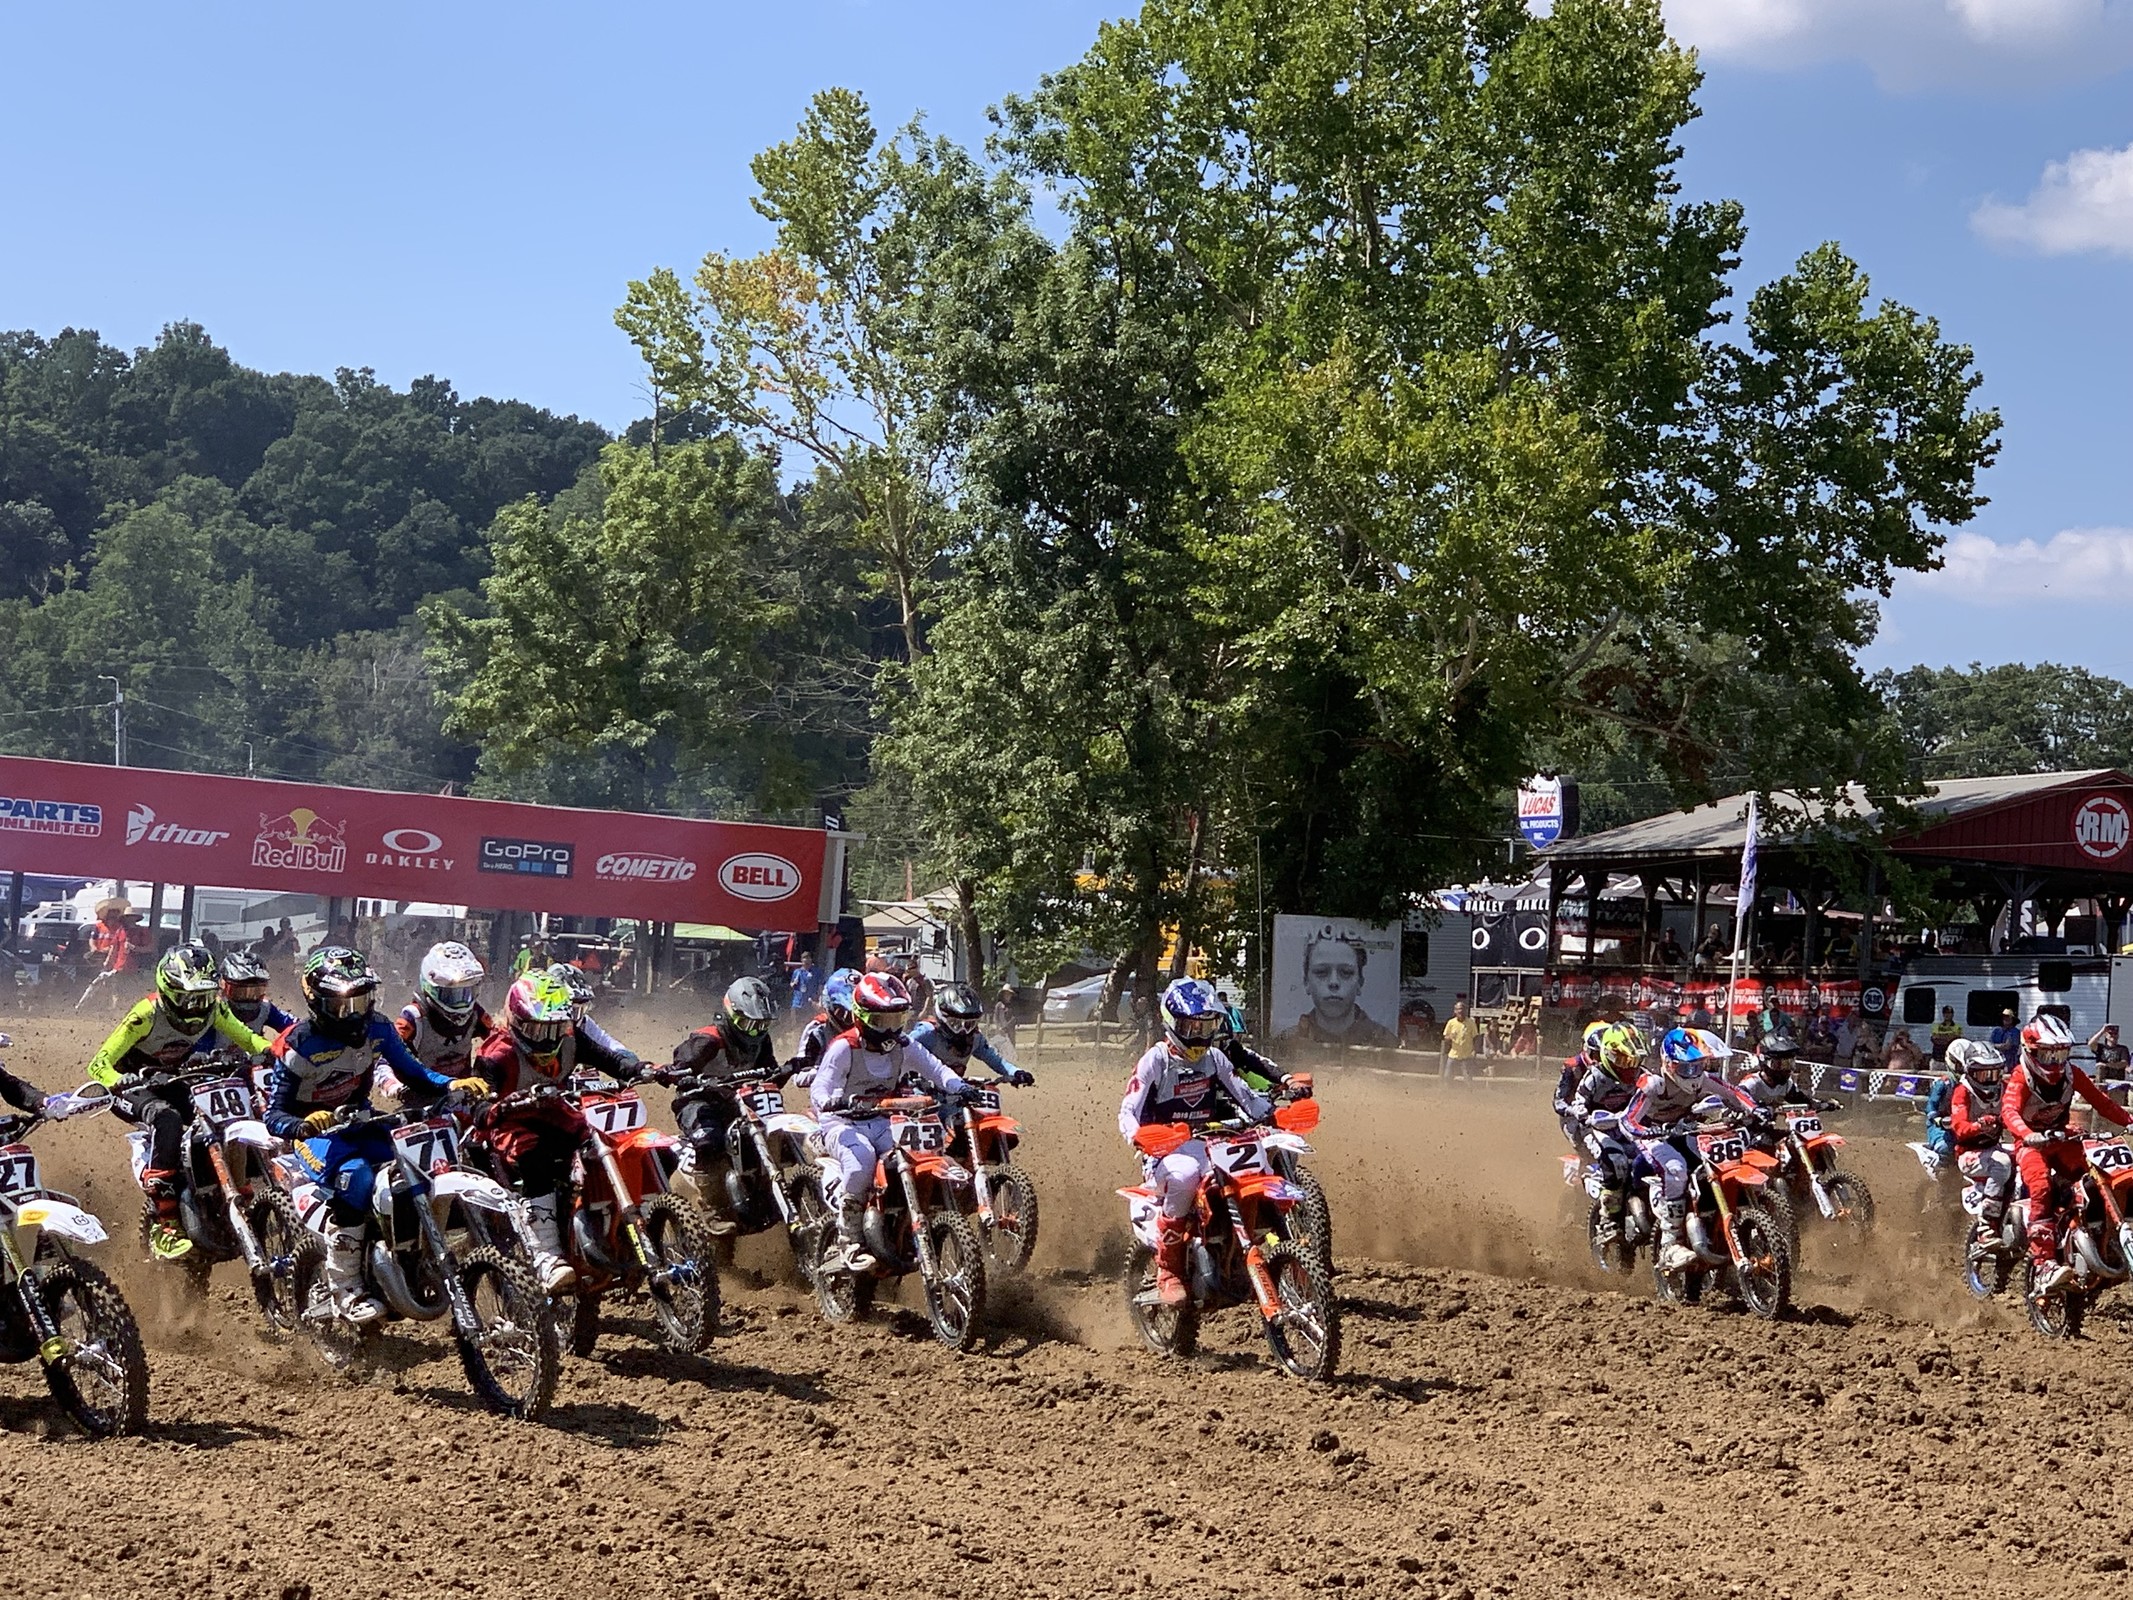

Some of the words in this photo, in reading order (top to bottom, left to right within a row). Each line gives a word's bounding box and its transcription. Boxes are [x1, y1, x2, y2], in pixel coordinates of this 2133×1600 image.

[1522, 796, 1556, 815] LUCAS
[0, 816, 100, 836] NLIMITED
[148, 823, 230, 846] thor
[1530, 820, 1559, 829] PRODUCTS
[2083, 811, 2121, 843] RM
[252, 840, 300, 869] Red
[300, 843, 346, 873] Bull
[365, 852, 455, 871] OAKLEY
[484, 840, 570, 862] GoPro
[596, 854, 697, 881] COMETIC
[732, 865, 788, 887] BELL
[1464, 900, 1505, 912] OAKLEY
[210, 1088, 246, 1118] 48
[754, 1092, 784, 1113] 32
[595, 1101, 638, 1131] 77
[1795, 1119, 1821, 1133] 68
[899, 1124, 943, 1151] 43
[405, 1129, 458, 1172] 71
[1226, 1144, 1260, 1173] 2
[1709, 1141, 1743, 1164] 86
[2093, 1146, 2133, 1169] 26
[1254, 1262, 1277, 1303] DUNLOP
